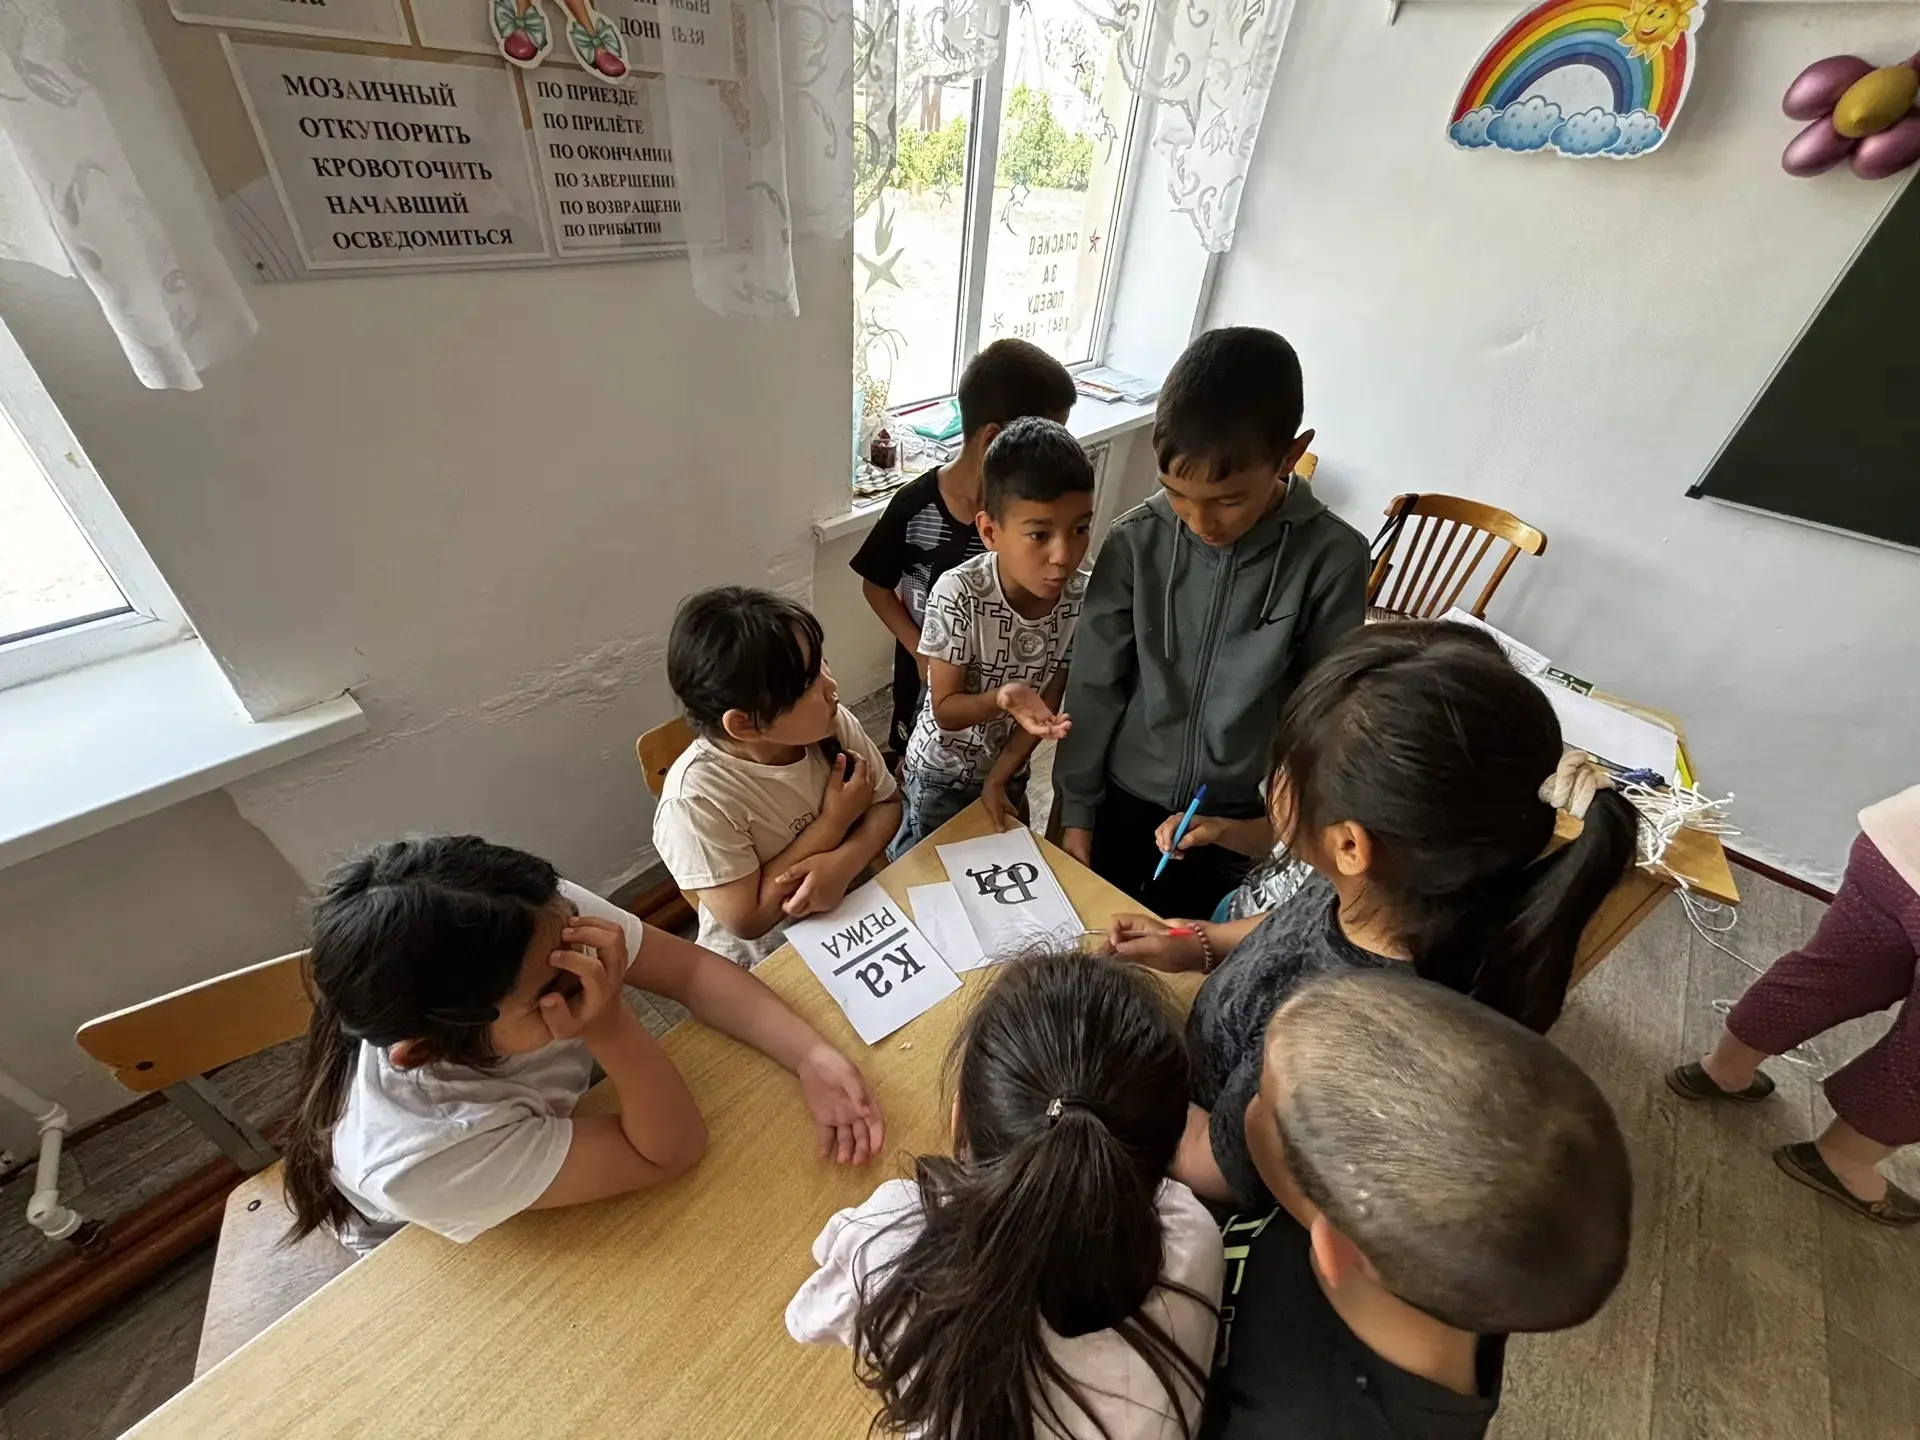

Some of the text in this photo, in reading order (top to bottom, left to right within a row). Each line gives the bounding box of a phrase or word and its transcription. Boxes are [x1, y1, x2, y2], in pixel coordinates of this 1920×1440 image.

[282, 74, 458, 108] МОЗАИЧНЫЙ
[537, 81, 638, 106] ПО ПРИЕЗДЕ
[299, 117, 471, 144] ОТКУПОРИТЬ
[542, 112, 645, 135] ПО ПРИЛЁТЕ
[549, 143, 673, 163] ПО ОКОНЧАНИИ
[312, 157, 493, 181] КРОВОТОЧИТЬ
[554, 172, 578, 188] ПО
[325, 193, 469, 215] НАЧАВШИЙ
[559, 200, 583, 215] ПО
[333, 228, 513, 251] ОСВЕДОМИТЬСЯ
[564, 222, 662, 238] ПО ПРИБЫТИИ
[821, 906, 897, 959] РЕЙКА
